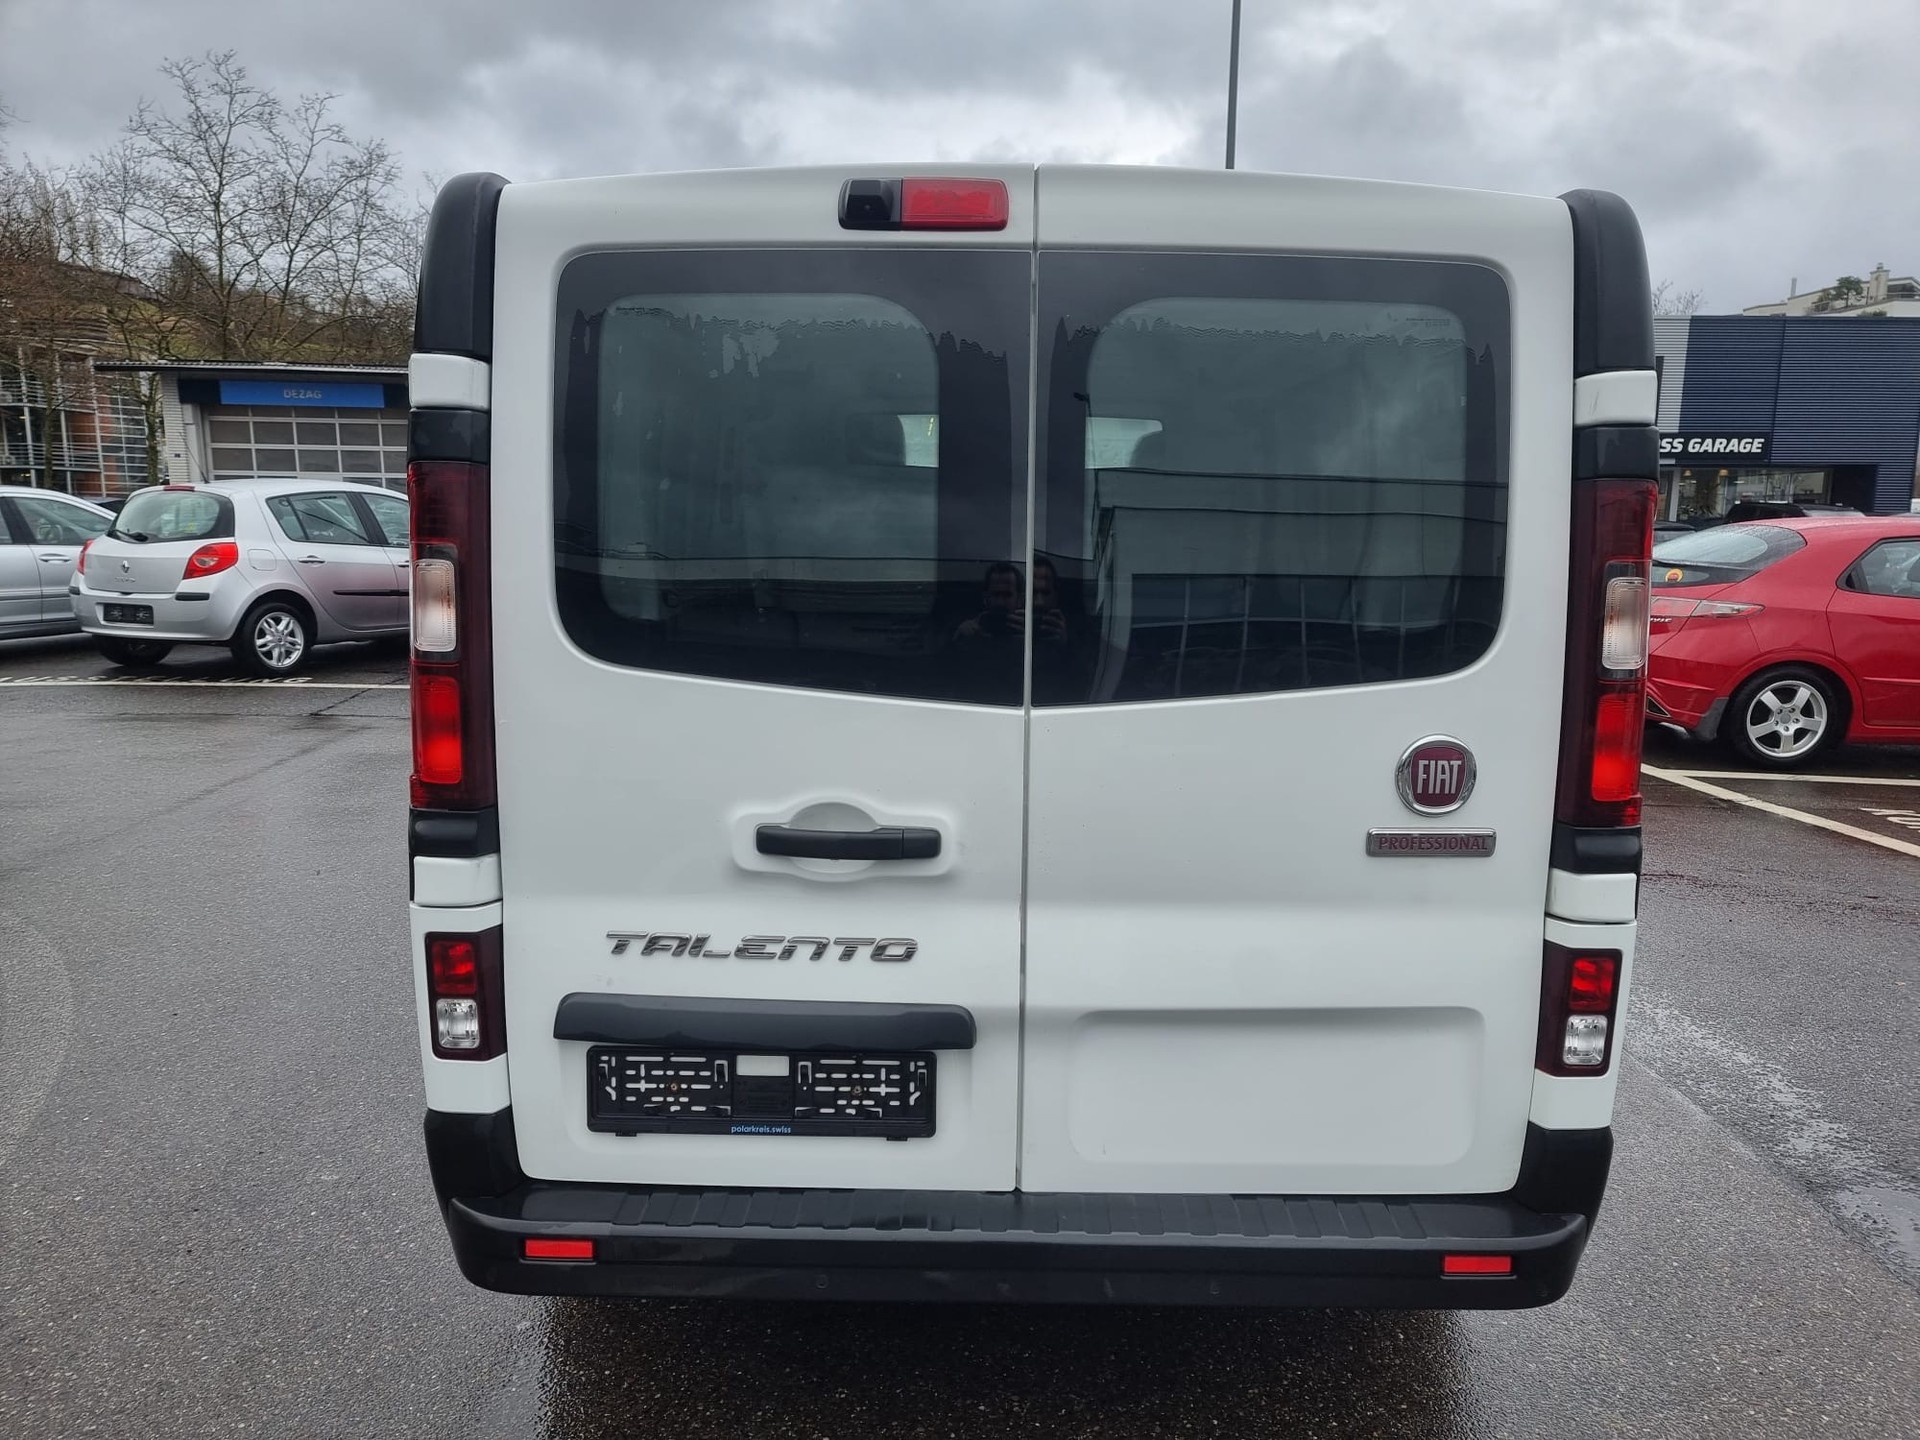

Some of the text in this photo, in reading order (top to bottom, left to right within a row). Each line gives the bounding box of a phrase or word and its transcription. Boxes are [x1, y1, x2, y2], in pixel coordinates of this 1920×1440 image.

[283, 389, 322, 399] DEZAG
[1658, 438, 1765, 453] SS GARAGE
[1417, 759, 1462, 795] FIAT
[1378, 836, 1488, 850] PROFESSIONAL
[605, 930, 919, 962] TALENTO
[731, 1125, 791, 1134] polarkreis.swiss
